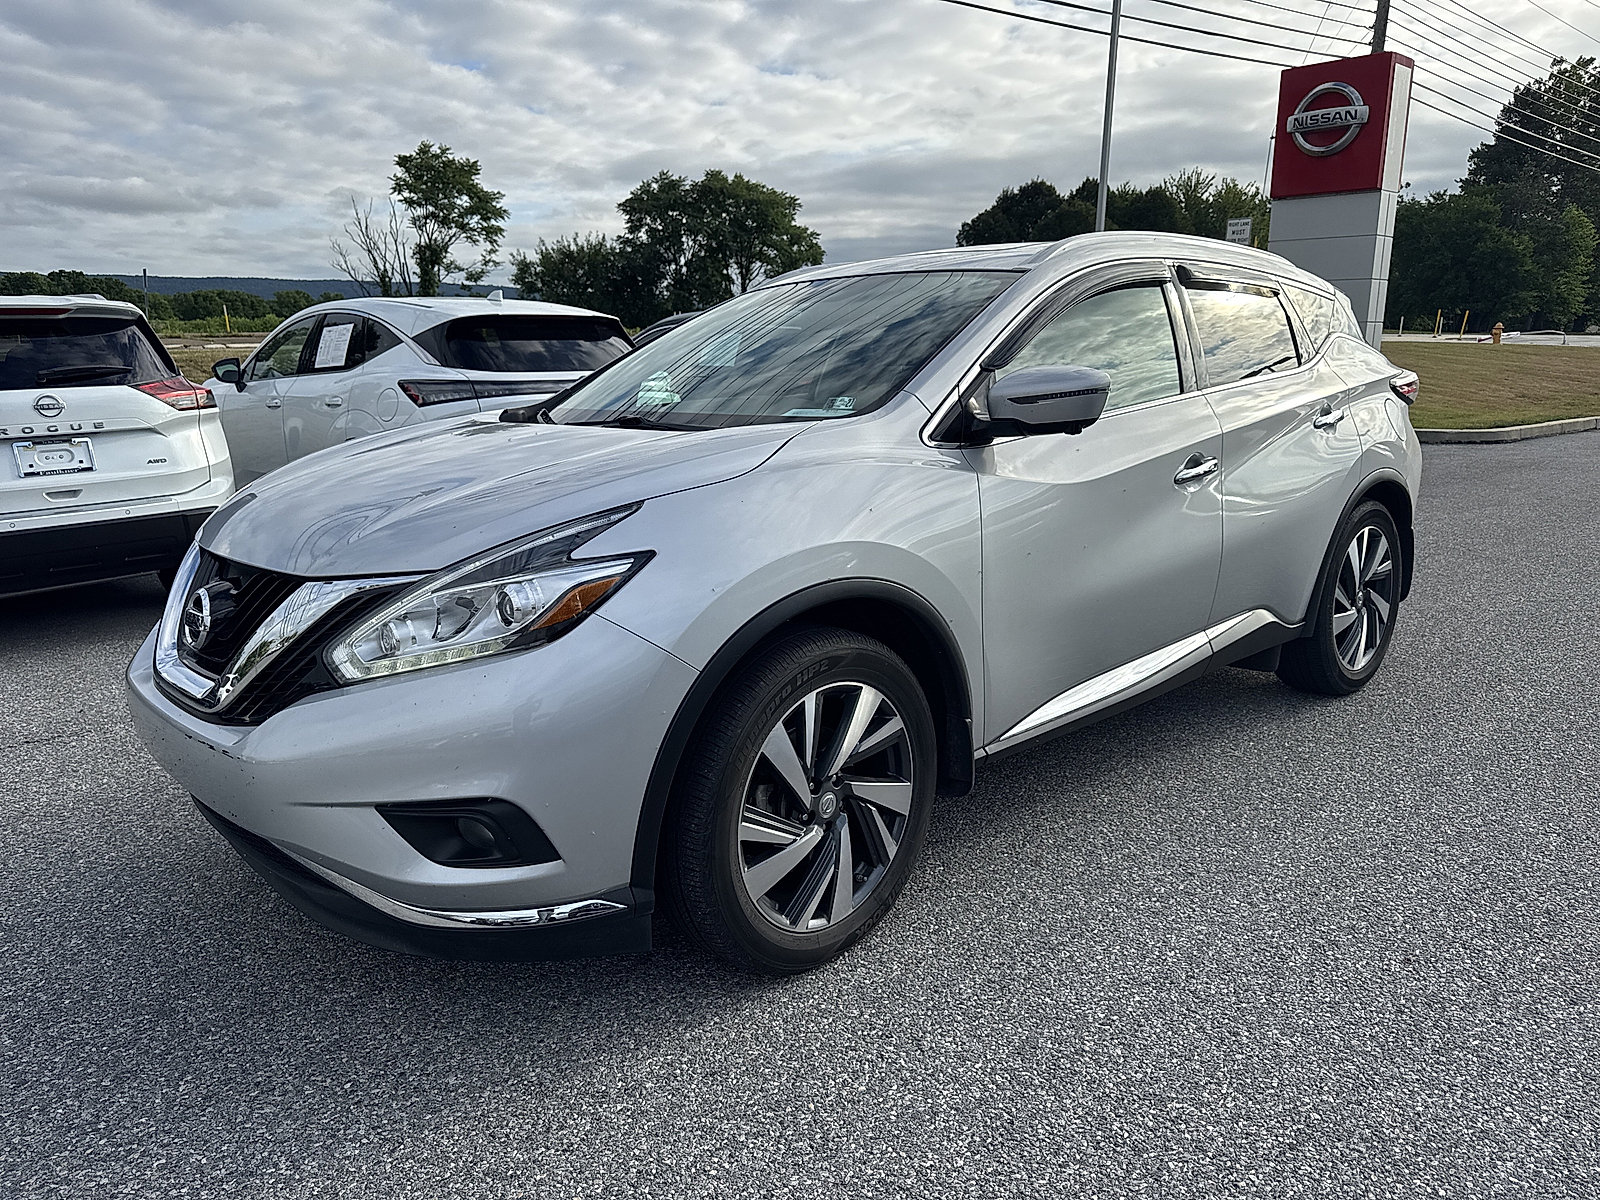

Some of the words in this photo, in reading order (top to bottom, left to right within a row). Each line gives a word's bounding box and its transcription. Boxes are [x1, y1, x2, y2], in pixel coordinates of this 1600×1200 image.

[1293, 109, 1358, 130] NISSAN
[0, 421, 105, 436] ROGUE
[146, 457, 168, 465] AWD
[39, 468, 80, 476] Faulkner
[796, 658, 831, 688] HP2
